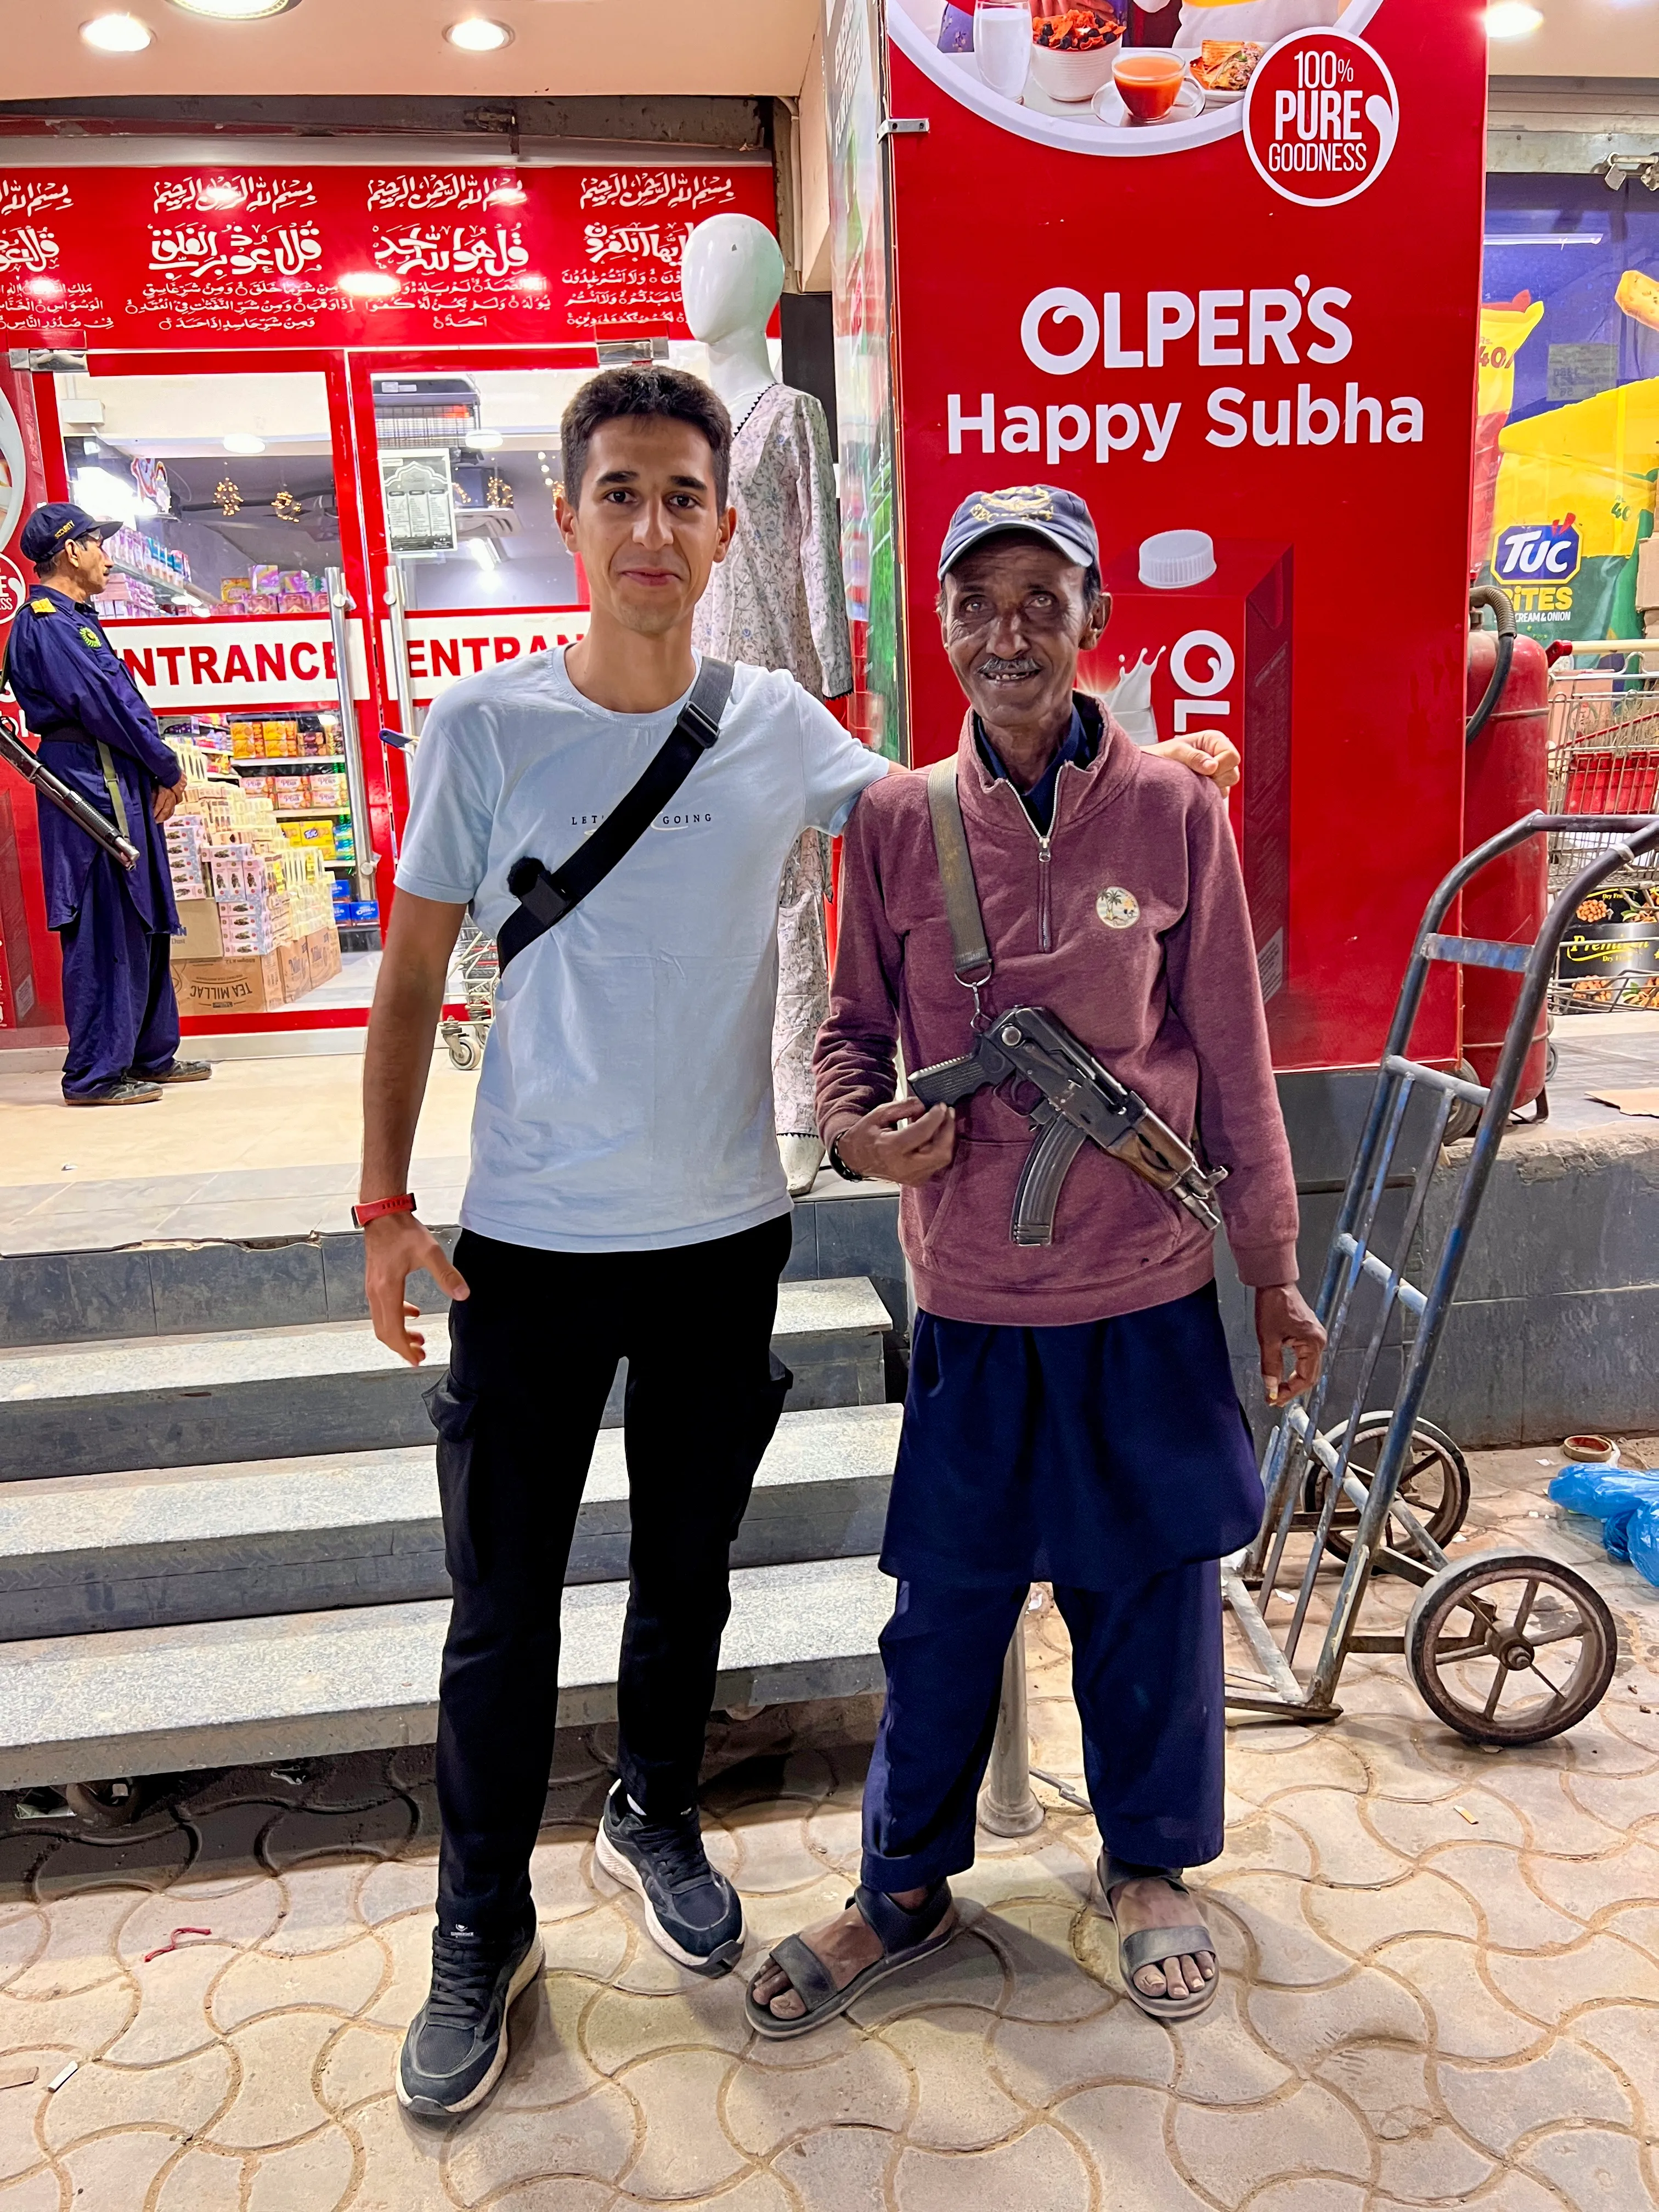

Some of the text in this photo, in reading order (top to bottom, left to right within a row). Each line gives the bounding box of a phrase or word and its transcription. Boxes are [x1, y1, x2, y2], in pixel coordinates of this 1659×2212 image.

[1294, 51, 1354, 83] 100%
[1275, 91, 1362, 140] PURE
[1269, 144, 1367, 172] GOODNESS
[1020, 274, 1353, 375] OLPER'S
[947, 382, 1425, 465] Happy Subha
[1502, 529, 1572, 573] TUC
[1547, 611, 1571, 621] ONION
[114, 641, 337, 686] NTRANCE
[663, 813, 712, 825] GOING
[189, 982, 253, 1000] TEA MILLAC
